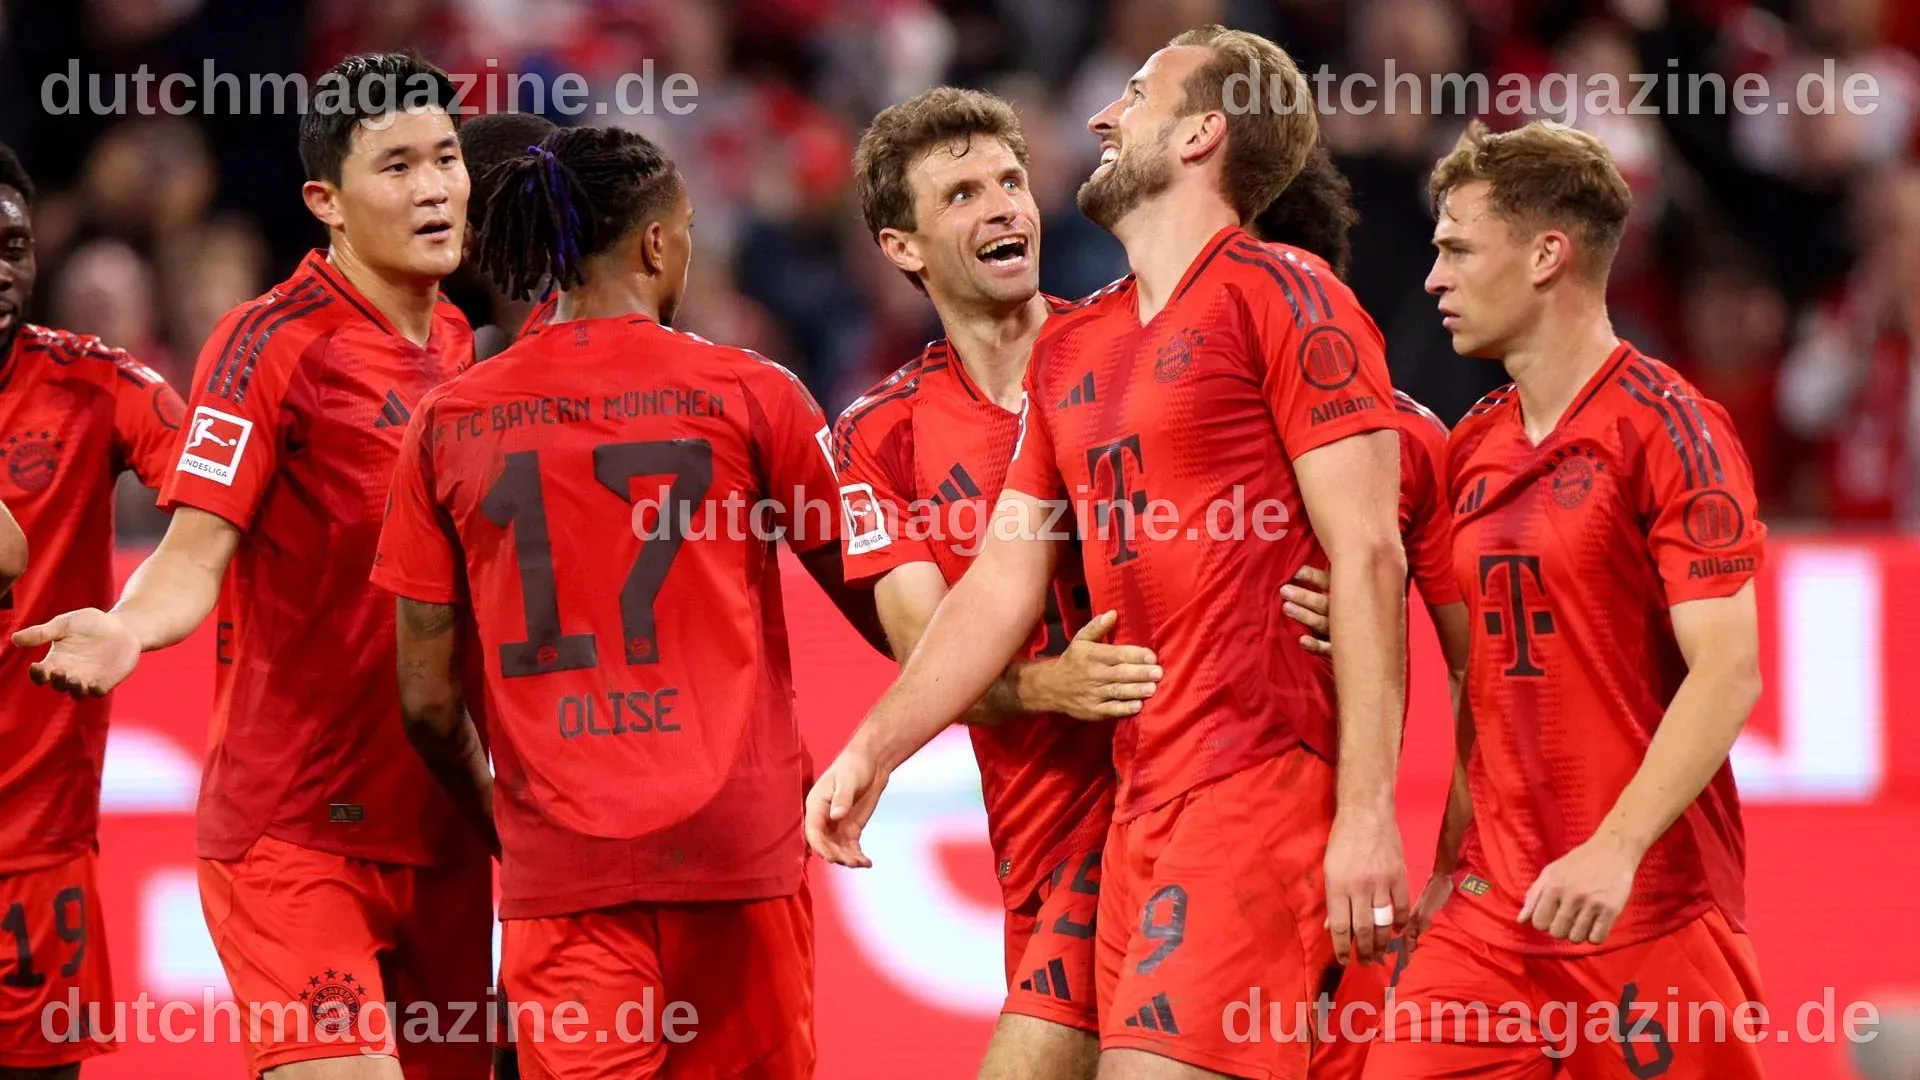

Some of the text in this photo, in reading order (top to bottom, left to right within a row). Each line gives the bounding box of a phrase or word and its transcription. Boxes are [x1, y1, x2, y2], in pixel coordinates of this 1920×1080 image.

[456, 388, 725, 442] FC BAYERN MÜNCHEN
[1310, 395, 1376, 427] Allianz
[480, 438, 714, 679] 17
[1687, 556, 1756, 581] Allianz
[558, 688, 682, 740] OLISE
[1, 887, 87, 988] 19
[1136, 884, 1189, 974] 9
[1614, 981, 1675, 1080] 6
